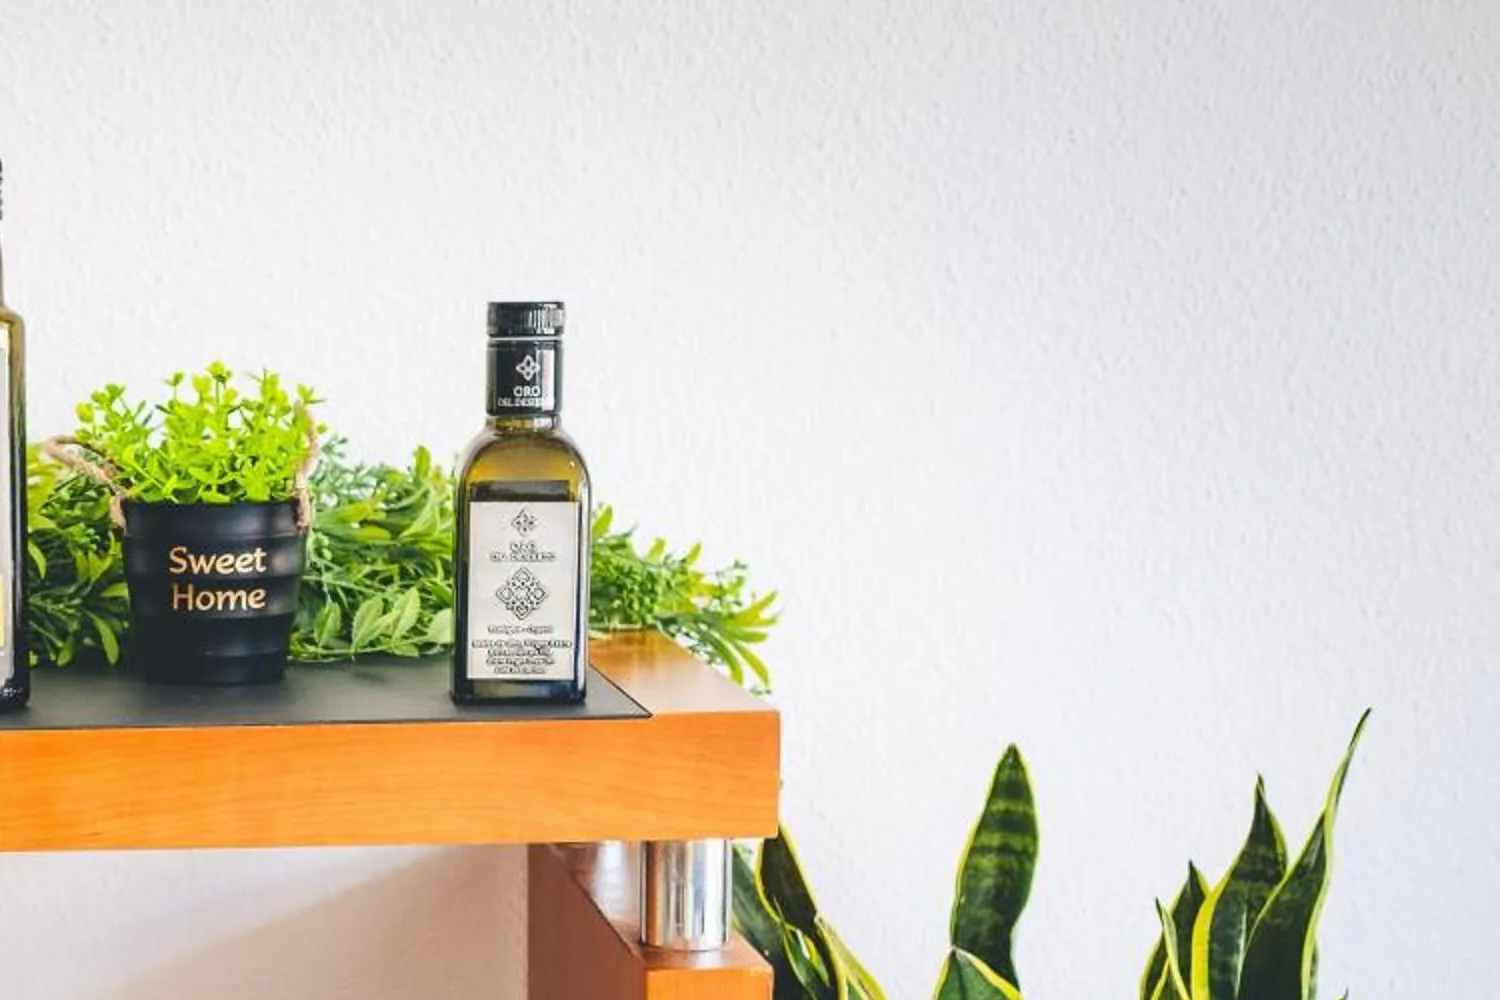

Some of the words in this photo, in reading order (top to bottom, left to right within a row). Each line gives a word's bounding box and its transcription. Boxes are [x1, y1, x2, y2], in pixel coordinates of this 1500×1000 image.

[513, 385, 541, 397] ORO
[168, 545, 267, 575] Sweet
[171, 583, 267, 612] Home
